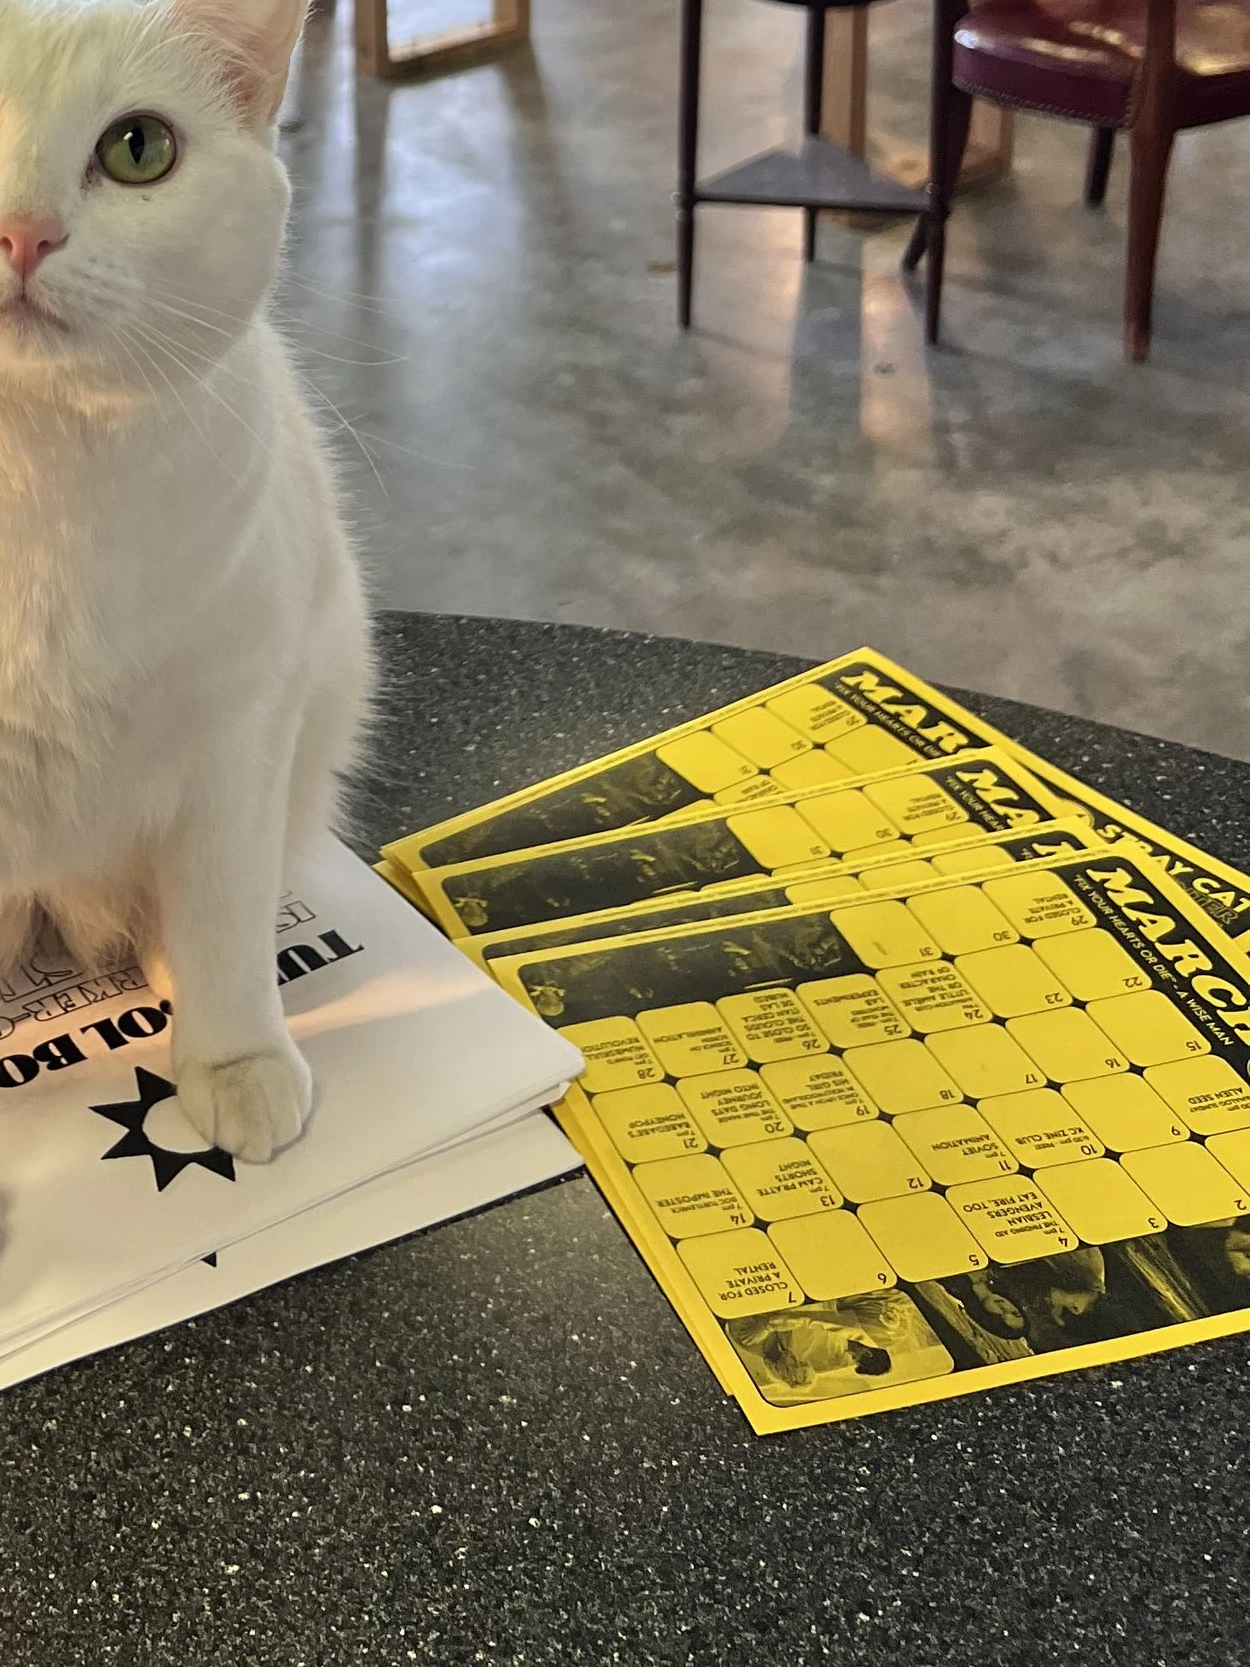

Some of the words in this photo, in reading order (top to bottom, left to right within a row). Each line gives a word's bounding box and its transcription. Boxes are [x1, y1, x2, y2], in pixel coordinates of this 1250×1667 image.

[840, 670, 968, 754] MAR
[1044, 907, 1081, 919] CLOSED
[1024, 916, 1044, 924] FOR
[1071, 915, 1088, 926] 29
[993, 931, 1011, 941] 30
[919, 947, 934, 957] 31
[1087, 891, 1115, 915] YOUR
[1109, 915, 1146, 949] HEARTS
[1140, 949, 1158, 964] OR
[1176, 990, 1188, 999] A
[1186, 997, 1212, 1022] WISE
[1205, 1021, 1234, 1046] MAN
[1122, 976, 1142, 988] 22
[1045, 992, 1063, 1004] 23
[964, 1009, 983, 1020] 24
[884, 1024, 902, 1035] 25
[580, 1037, 640, 1053] REVOLUTIO
[802, 1038, 821, 1050] 26
[1186, 1041, 1202, 1051] 15
[723, 1053, 739, 1065] 27
[1105, 1058, 1120, 1068] 16
[637, 1068, 655, 1079] 28
[809, 1071, 844, 1082] FRIDAY
[806, 1082, 831, 1090] GIRL
[832, 1078, 850, 1086] HIS
[700, 1089, 732, 1099] NIGHT
[734, 1084, 760, 1093] INTO
[1214, 1087, 1243, 1099] ALIEN
[718, 1091, 762, 1106] JOURNEY
[939, 1090, 955, 1100] 18
[1188, 1094, 1214, 1104] SEED
[739, 1100, 770, 1110] LONG
[856, 1105, 870, 1116] 19
[711, 1106, 739, 1116] DAYS
[628, 1113, 686, 1128] HONEYPOP
[764, 1122, 784, 1133] 20
[1068, 1127, 1084, 1135] KC
[1015, 1135, 1042, 1144] CLUB
[1043, 1130, 1068, 1140] ZINE
[683, 1138, 698, 1149] 21
[932, 1134, 990, 1151] ANIMATION
[962, 1143, 998, 1156] SOVIET
[1080, 1144, 1097, 1155] 10
[778, 1160, 811, 1172] NIGHT
[998, 1160, 1011, 1171] 11
[774, 1168, 818, 1182] SHORTS
[798, 1177, 823, 1188] CAM
[906, 1177, 924, 1189] 12
[711, 1188, 733, 1197] THE
[756, 1182, 797, 1196] PRATTE
[656, 1192, 710, 1207] IMPOSTER
[820, 1195, 835, 1206] 13
[988, 1196, 1016, 1207] FIRE,
[1017, 1192, 1038, 1202] EAT
[963, 1202, 988, 1212] TOO
[987, 1202, 1042, 1218] AVENGERS
[1234, 1200, 1247, 1210] 2
[730, 1213, 746, 1225] 14
[1006, 1211, 1052, 1226] LESBIAN
[733, 1262, 776, 1276] RENTAL
[726, 1274, 772, 1288] PRIVATE
[744, 1282, 788, 1296] CLOSED
[718, 1290, 743, 1300] FOR
